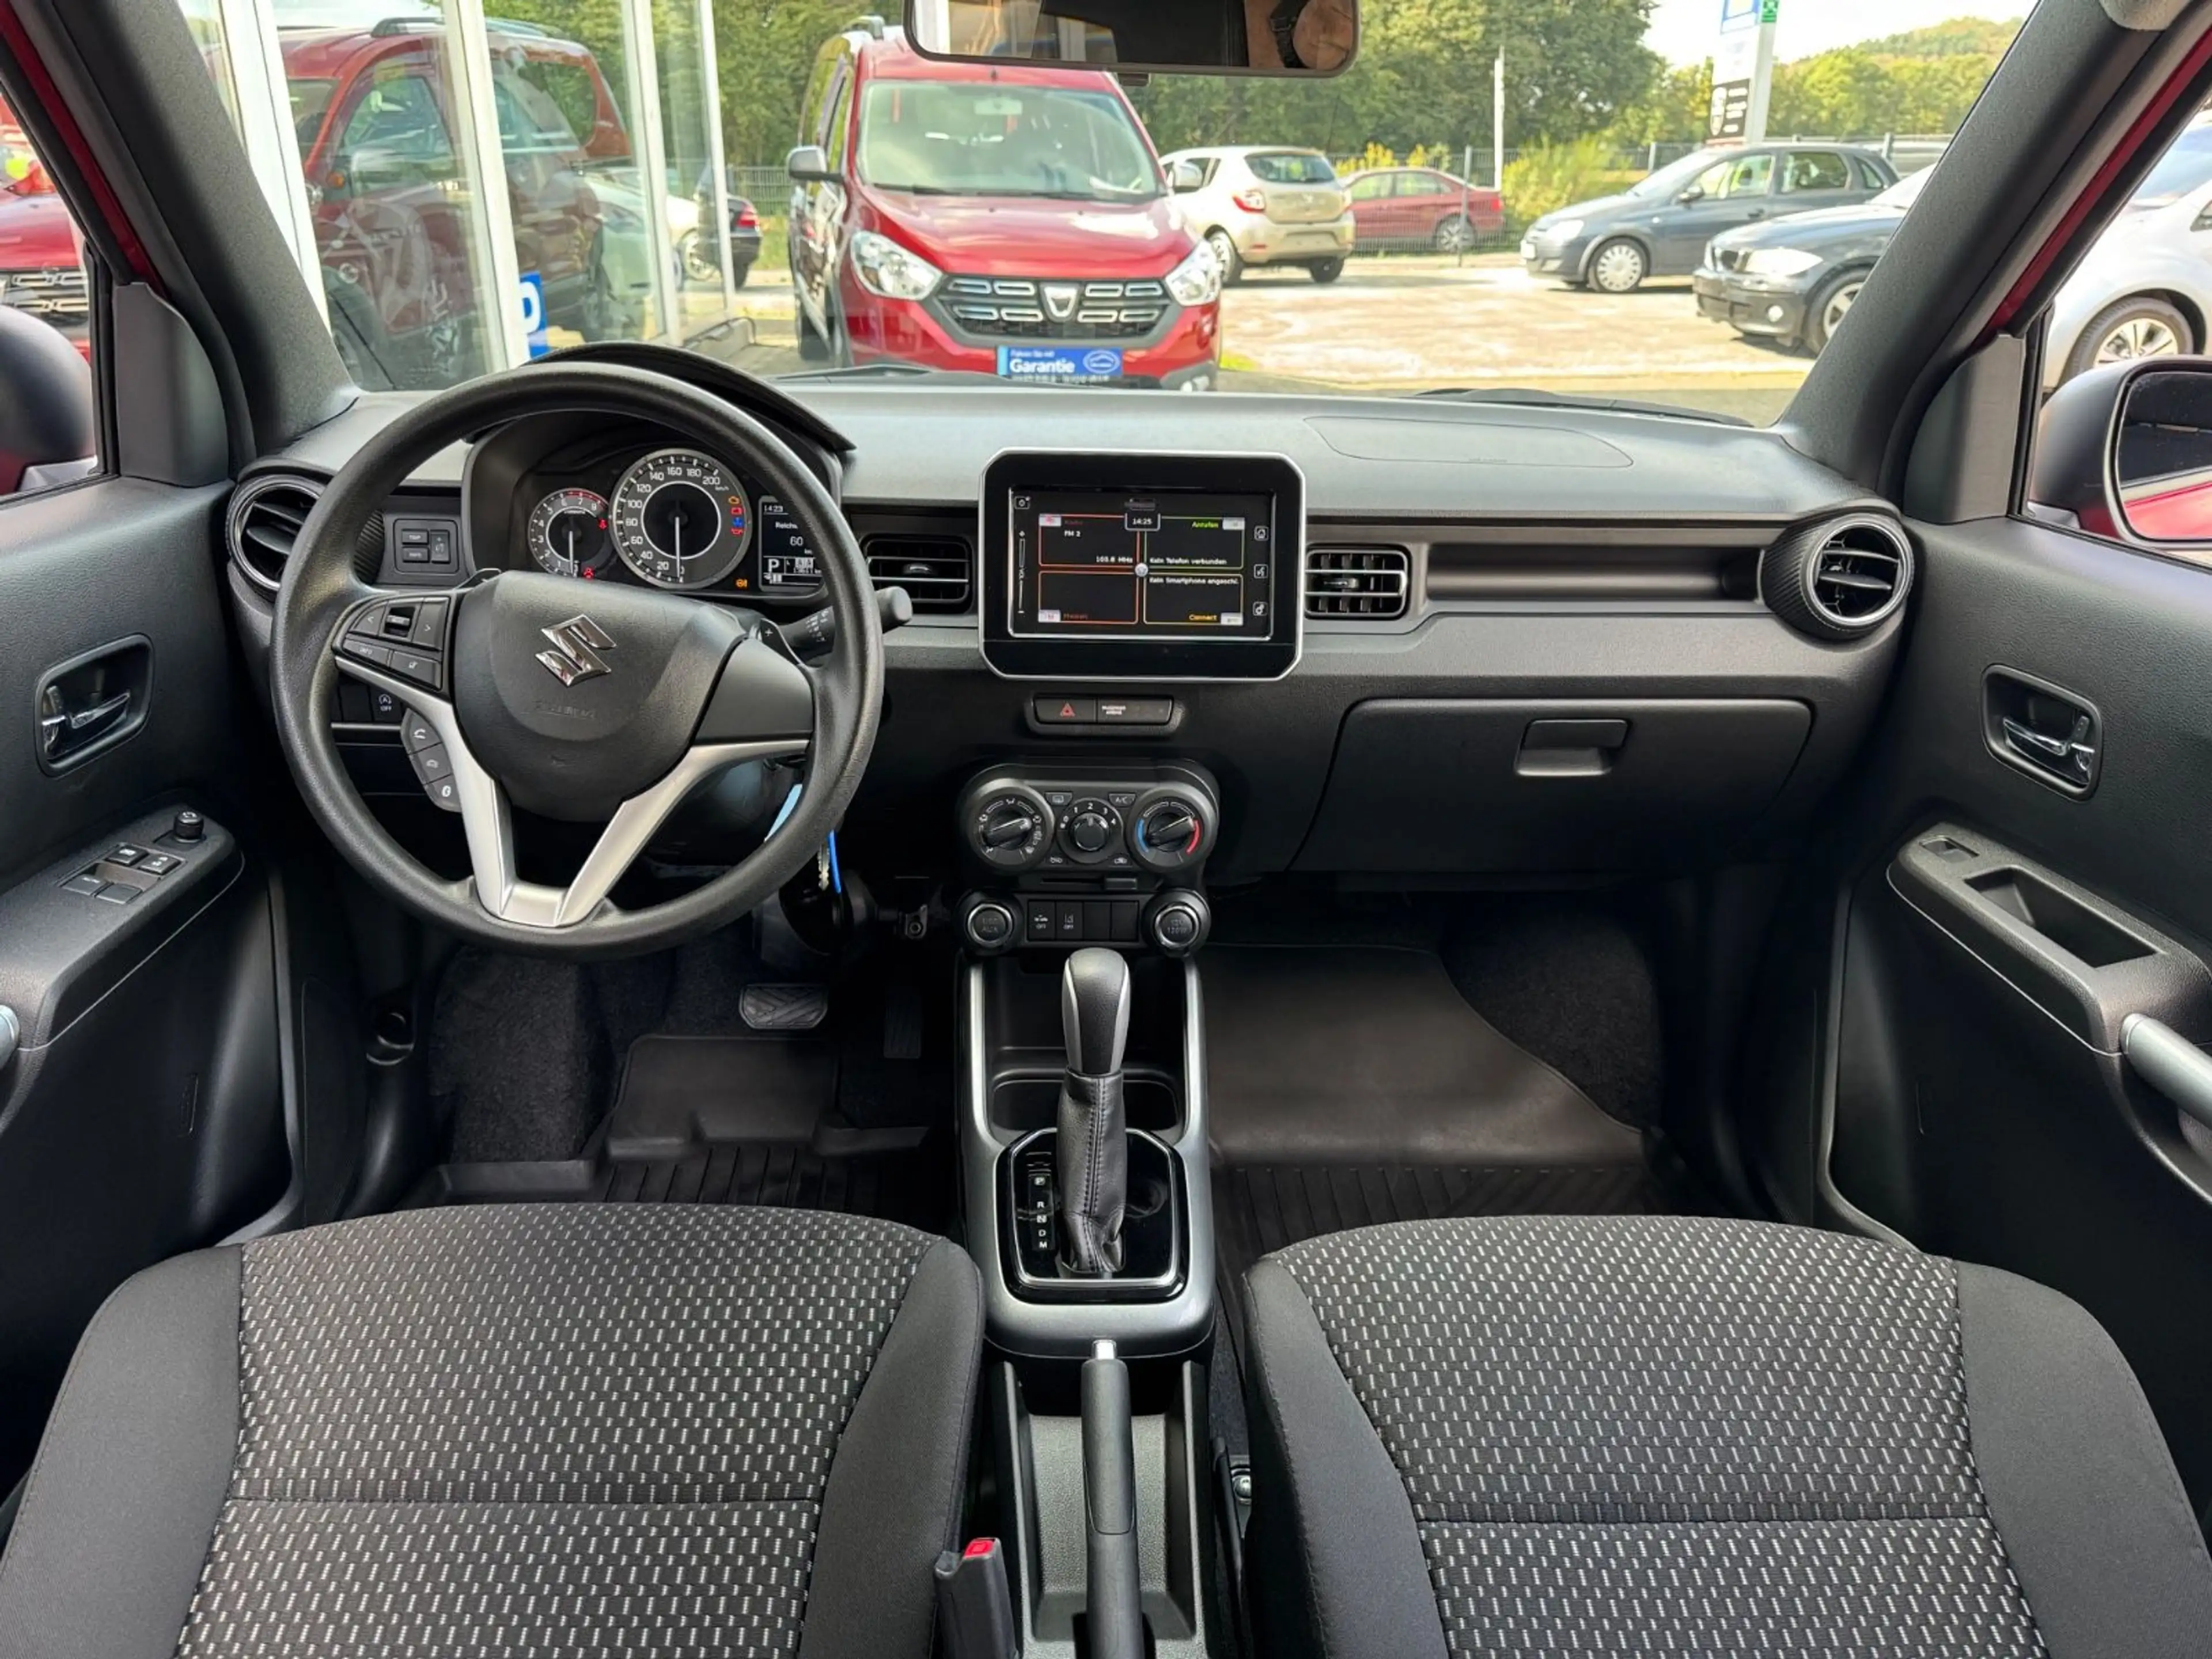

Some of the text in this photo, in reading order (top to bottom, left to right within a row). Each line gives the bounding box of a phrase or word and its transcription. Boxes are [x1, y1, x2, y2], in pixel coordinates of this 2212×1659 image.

[1010, 357, 1075, 373] Garantie
[667, 467, 682, 475] 160
[686, 468, 702, 477] 180
[650, 472, 664, 481] 140
[702, 477, 720, 485] 200
[637, 484, 652, 493] 120
[591, 503, 597, 511] 8
[627, 500, 642, 508] 100
[625, 518, 638, 527] 80
[630, 536, 643, 544] 60
[790, 536, 804, 547] 60
[640, 551, 653, 559] 40
[657, 562, 669, 570] 20
[768, 558, 779, 572] P
[1035, 1176, 1046, 1185] P
[1037, 1214, 1047, 1223] N
[1039, 1229, 1046, 1237] D
